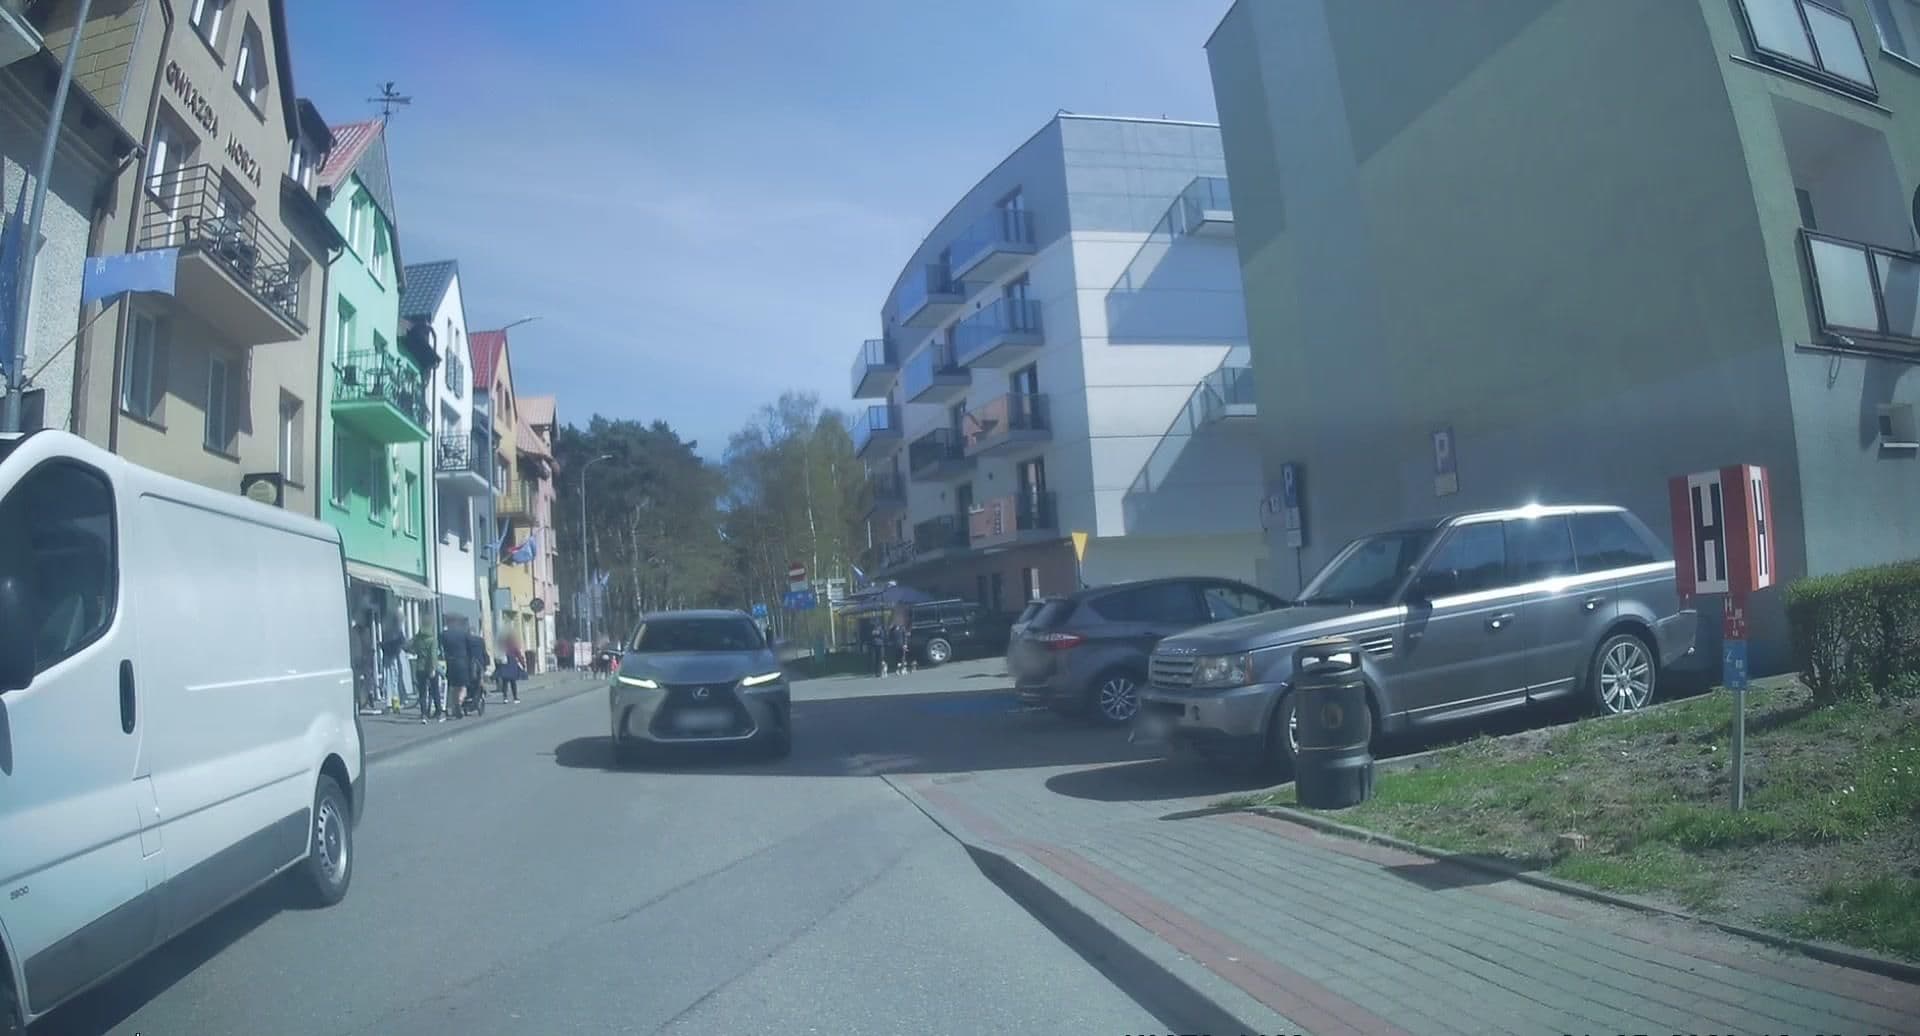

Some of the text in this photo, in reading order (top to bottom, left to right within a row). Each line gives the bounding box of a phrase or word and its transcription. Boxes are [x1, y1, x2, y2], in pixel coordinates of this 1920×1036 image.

[166, 59, 261, 188] GWIAZDA MORZA
[1435, 432, 1449, 471] P
[1691, 483, 1726, 581] H
[1752, 479, 1768, 576] H
